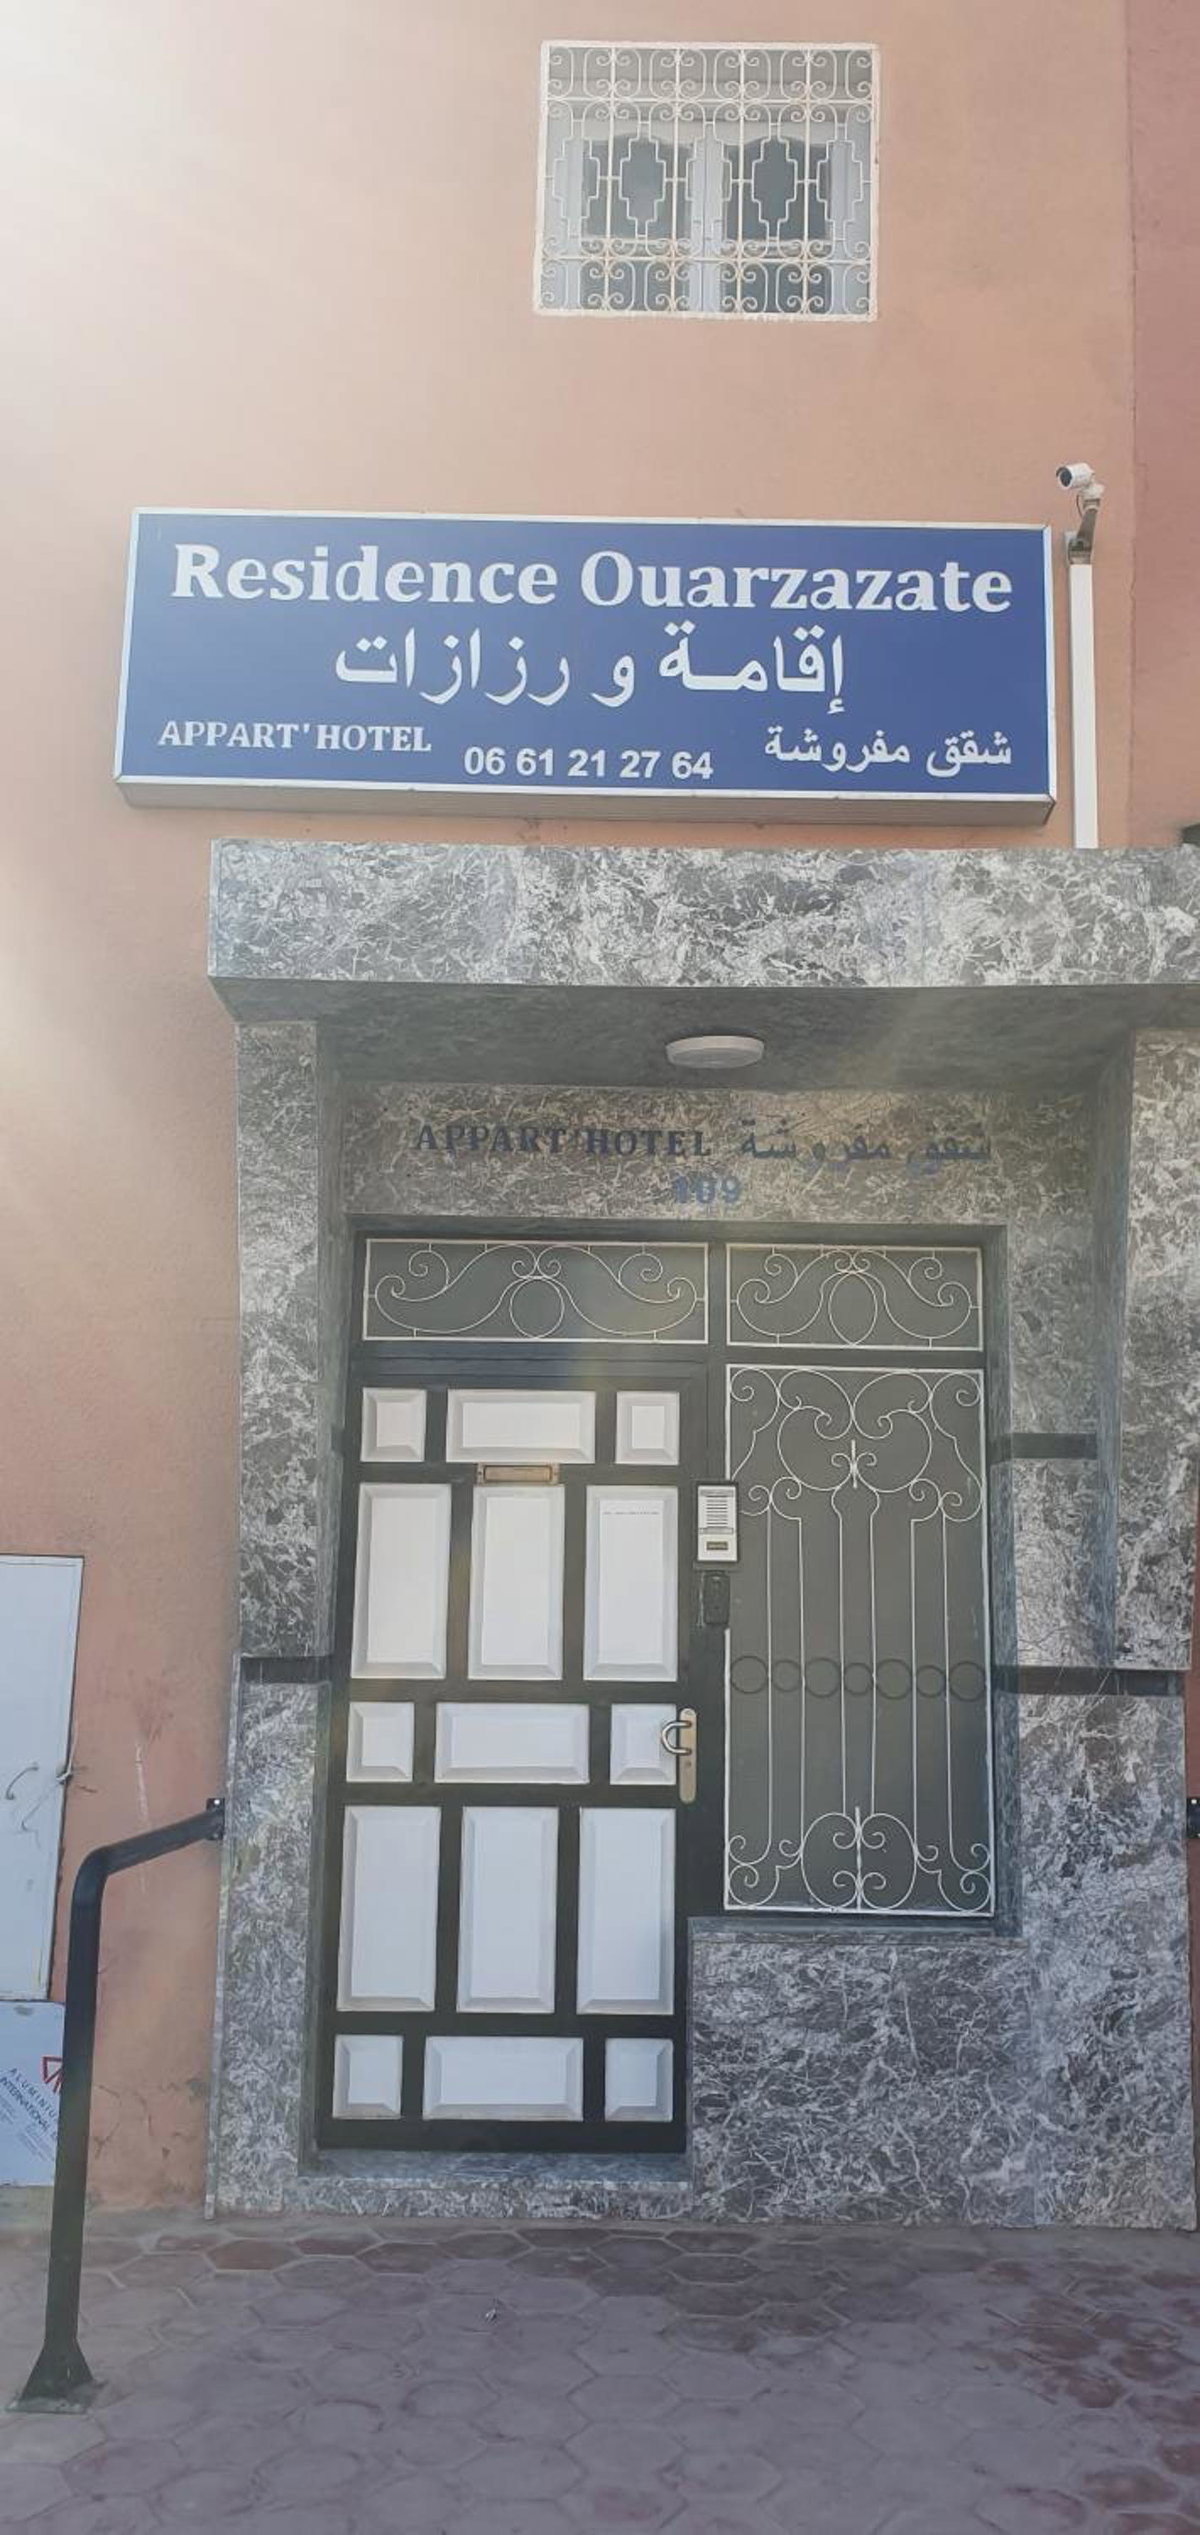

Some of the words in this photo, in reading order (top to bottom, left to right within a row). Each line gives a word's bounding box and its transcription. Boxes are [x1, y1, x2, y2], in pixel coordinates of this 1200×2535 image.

[170, 543, 557, 604] Residence
[580, 550, 1012, 612] Ouarzazate
[658, 620, 845, 714] إقامة
[464, 746, 506, 775] 06
[516, 748, 554, 776] 61
[567, 749, 605, 777] 21
[619, 750, 661, 778] 27
[671, 751, 713, 780] 64
[764, 725, 910, 773] مفروشة
[926, 730, 1012, 778] شقق
[9, 2066, 58, 2122] ALUMINIU
